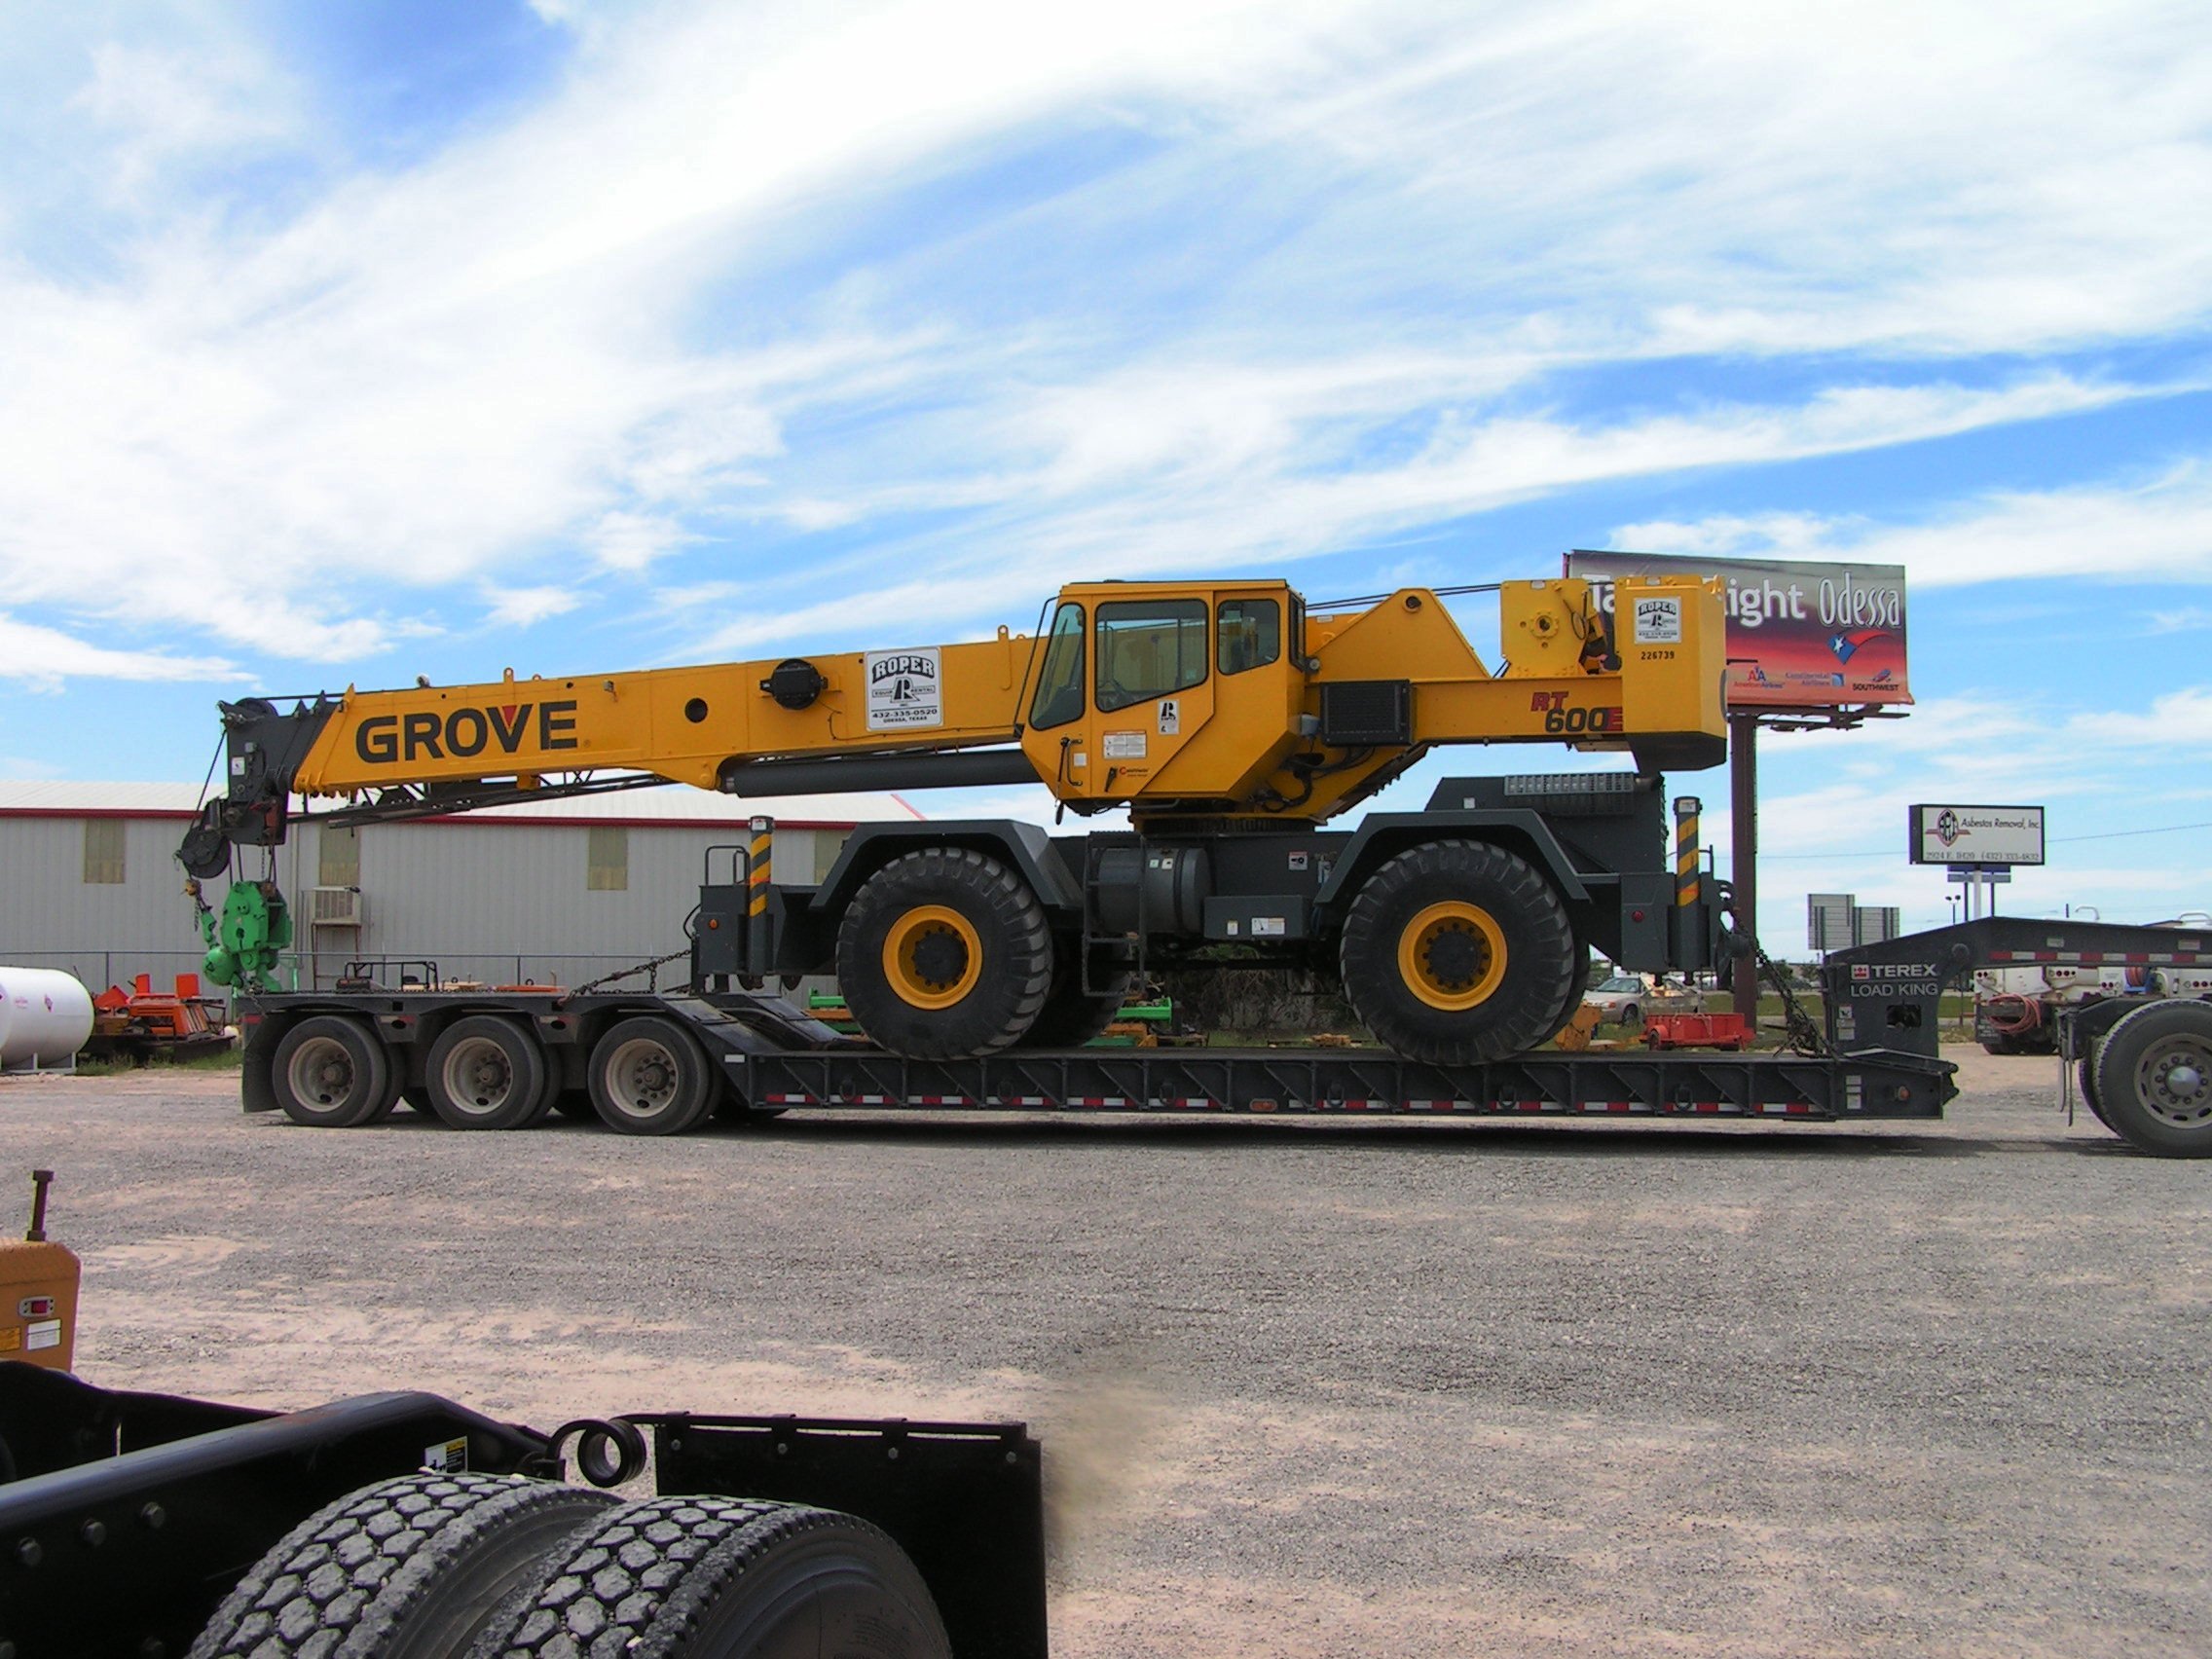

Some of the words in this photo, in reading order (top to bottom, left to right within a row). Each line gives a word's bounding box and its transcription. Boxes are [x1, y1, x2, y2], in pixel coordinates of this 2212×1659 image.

[1581, 573, 1615, 613] Ta
[1725, 578, 1806, 626] ight
[1818, 571, 1900, 627] Odessa
[1639, 601, 1677, 616] ROPER
[1641, 650, 1675, 660] 226739
[872, 655, 935, 684] ROPER
[1852, 682, 1899, 691] SOUTHWEST
[1530, 691, 1568, 712] RT
[872, 709, 938, 719] 432-335-0520
[355, 700, 578, 764] GROVE
[1961, 817, 1992, 828] Asbestos
[1871, 964, 1936, 977] TEREX
[1851, 983, 1894, 997] LOAD
[1899, 982, 1938, 996] KING
